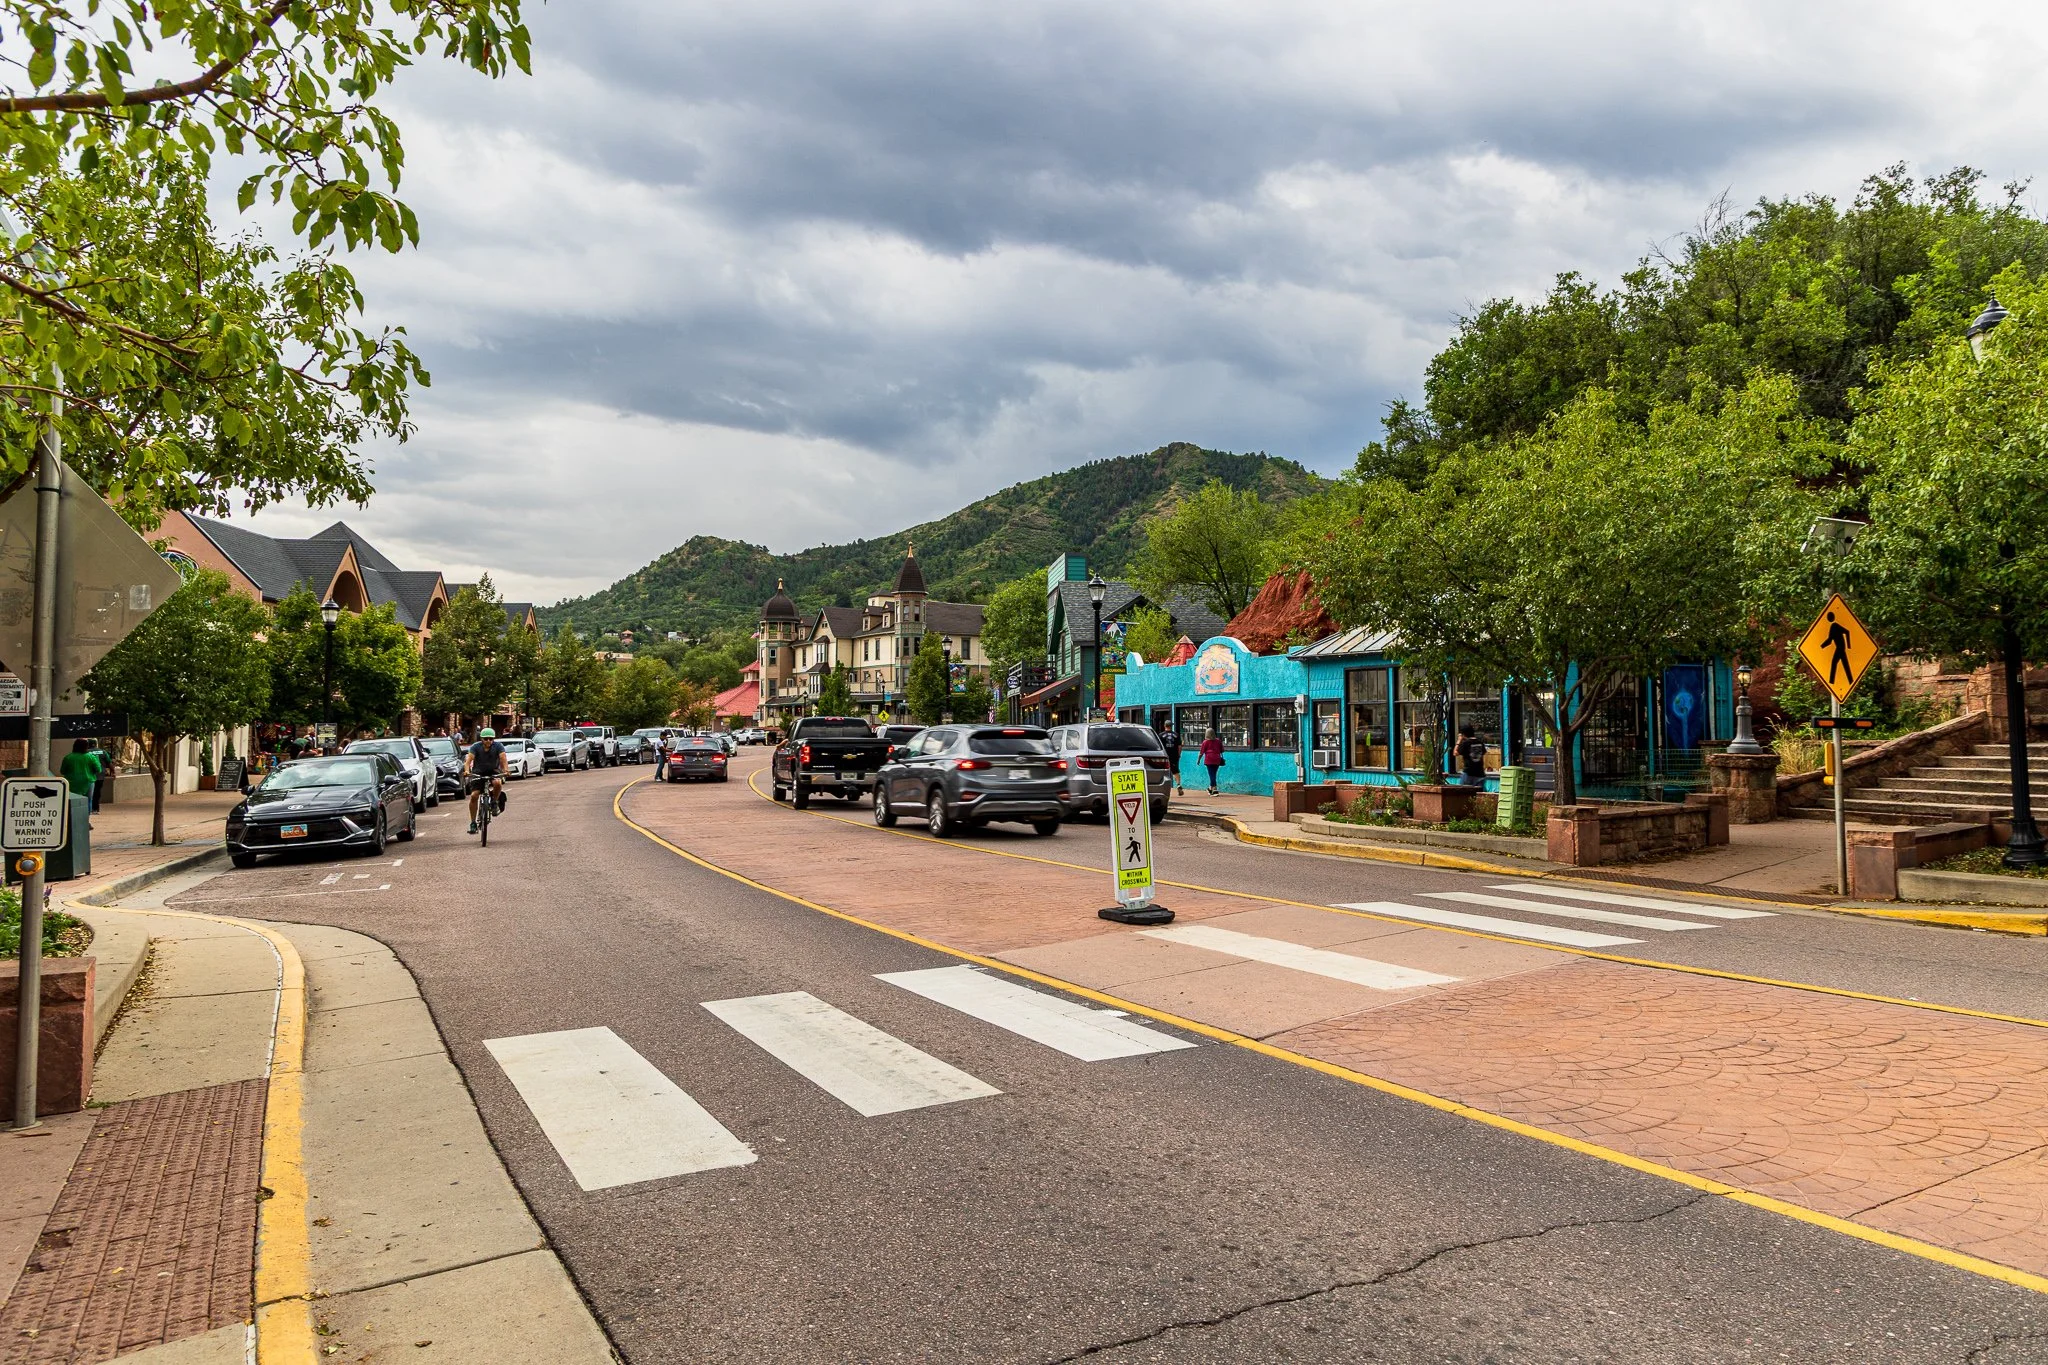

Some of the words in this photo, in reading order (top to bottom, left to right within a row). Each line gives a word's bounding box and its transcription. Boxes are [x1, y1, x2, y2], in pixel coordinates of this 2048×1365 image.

[1117, 774, 1139, 783] STATE
[1121, 783, 1136, 791] LAW
[23, 801, 46, 809] PUSH
[10, 810, 42, 818] BUTTON
[47, 809, 58, 818] TO
[14, 819, 36, 827] TURN
[41, 819, 53, 827] ON
[14, 828, 52, 836] WARNING
[17, 837, 47, 845] LIGHTS
[1121, 877, 1148, 886] CROSSWALK
